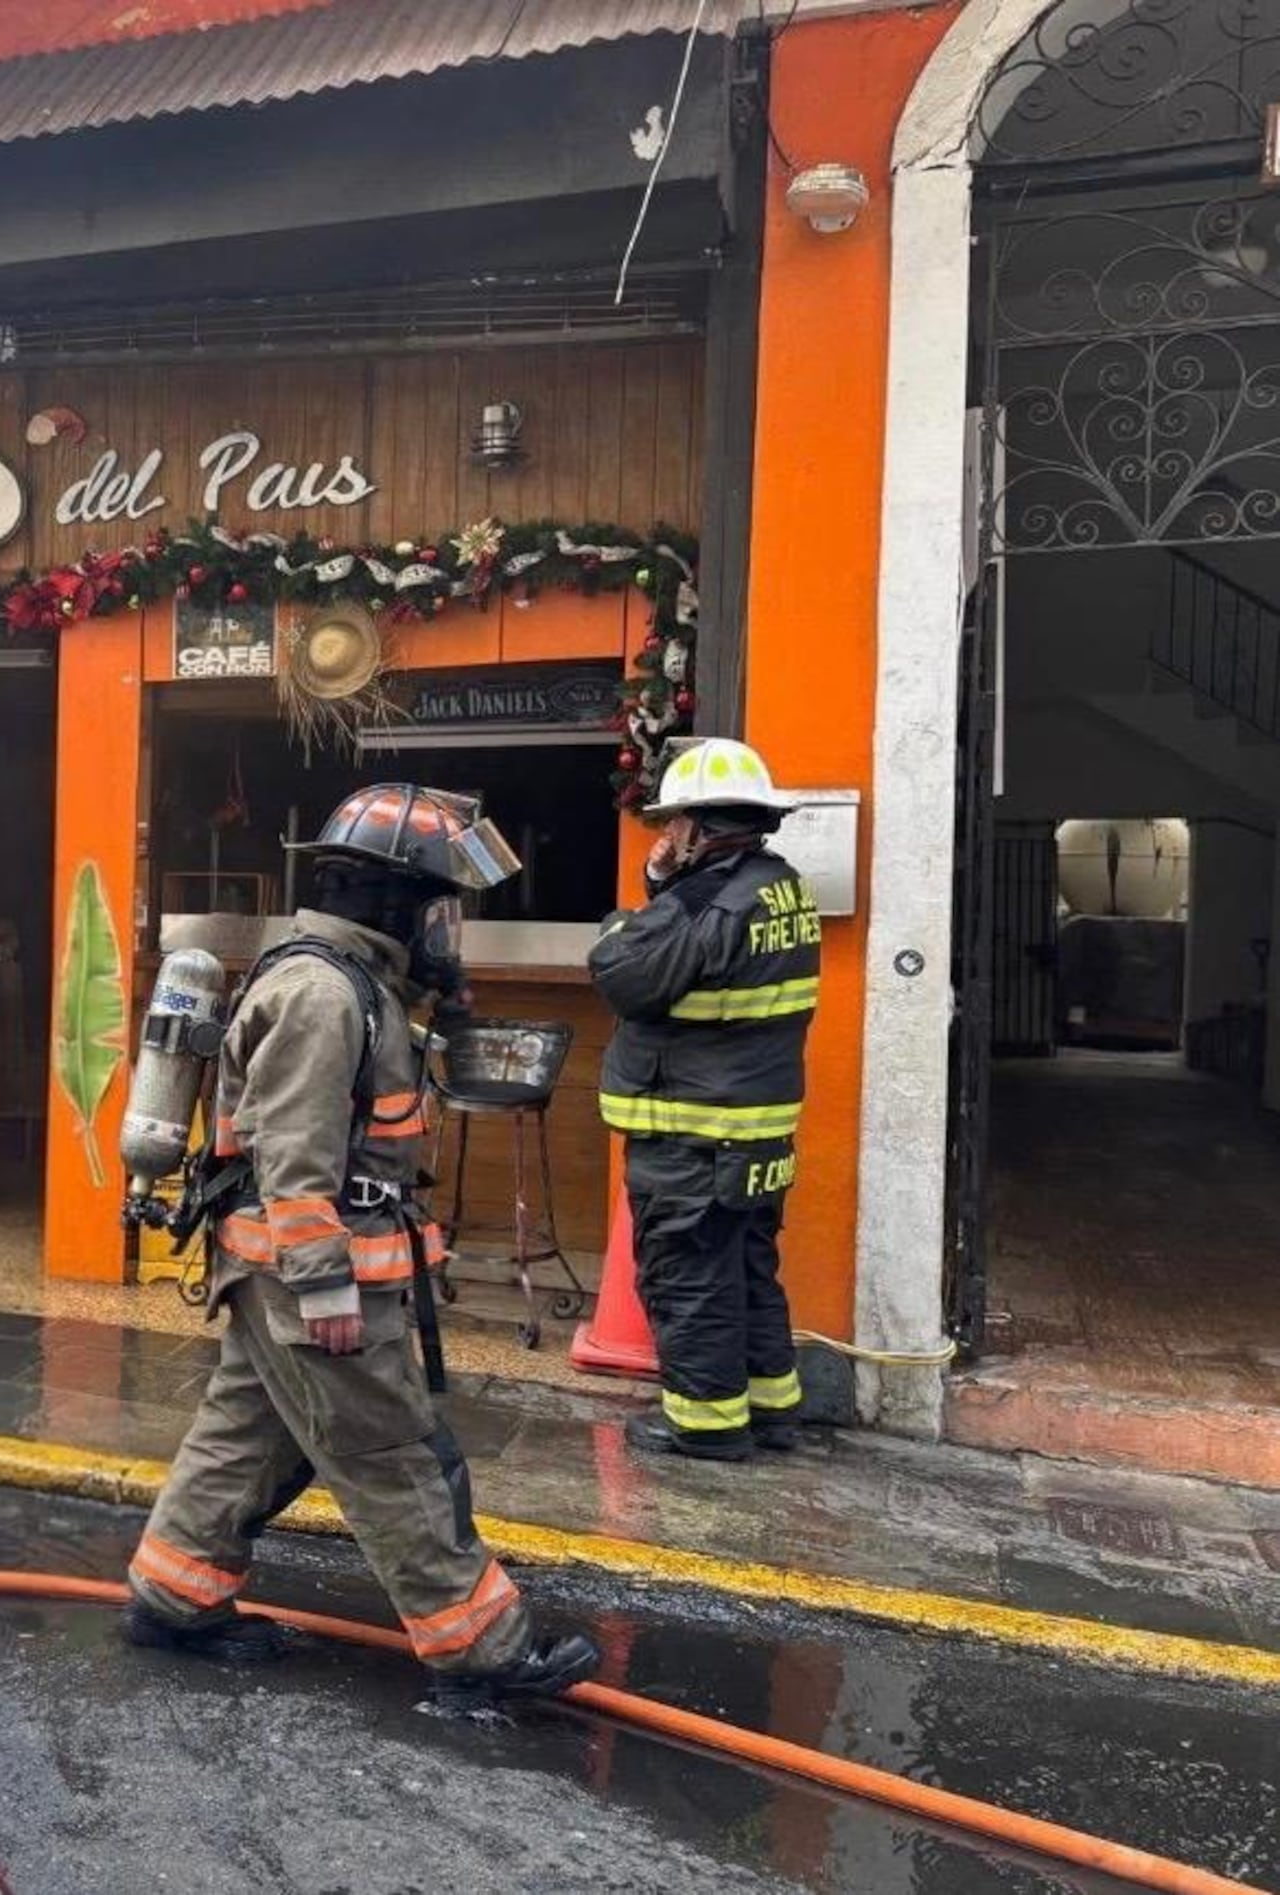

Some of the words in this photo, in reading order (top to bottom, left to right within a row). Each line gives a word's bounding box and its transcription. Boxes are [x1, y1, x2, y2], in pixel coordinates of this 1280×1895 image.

[56, 448, 165, 525] del
[178, 640, 271, 666] CAFÉ
[178, 663, 223, 677] CON
[414, 691, 464, 719] JACK
[757, 878, 798, 917] SAN
